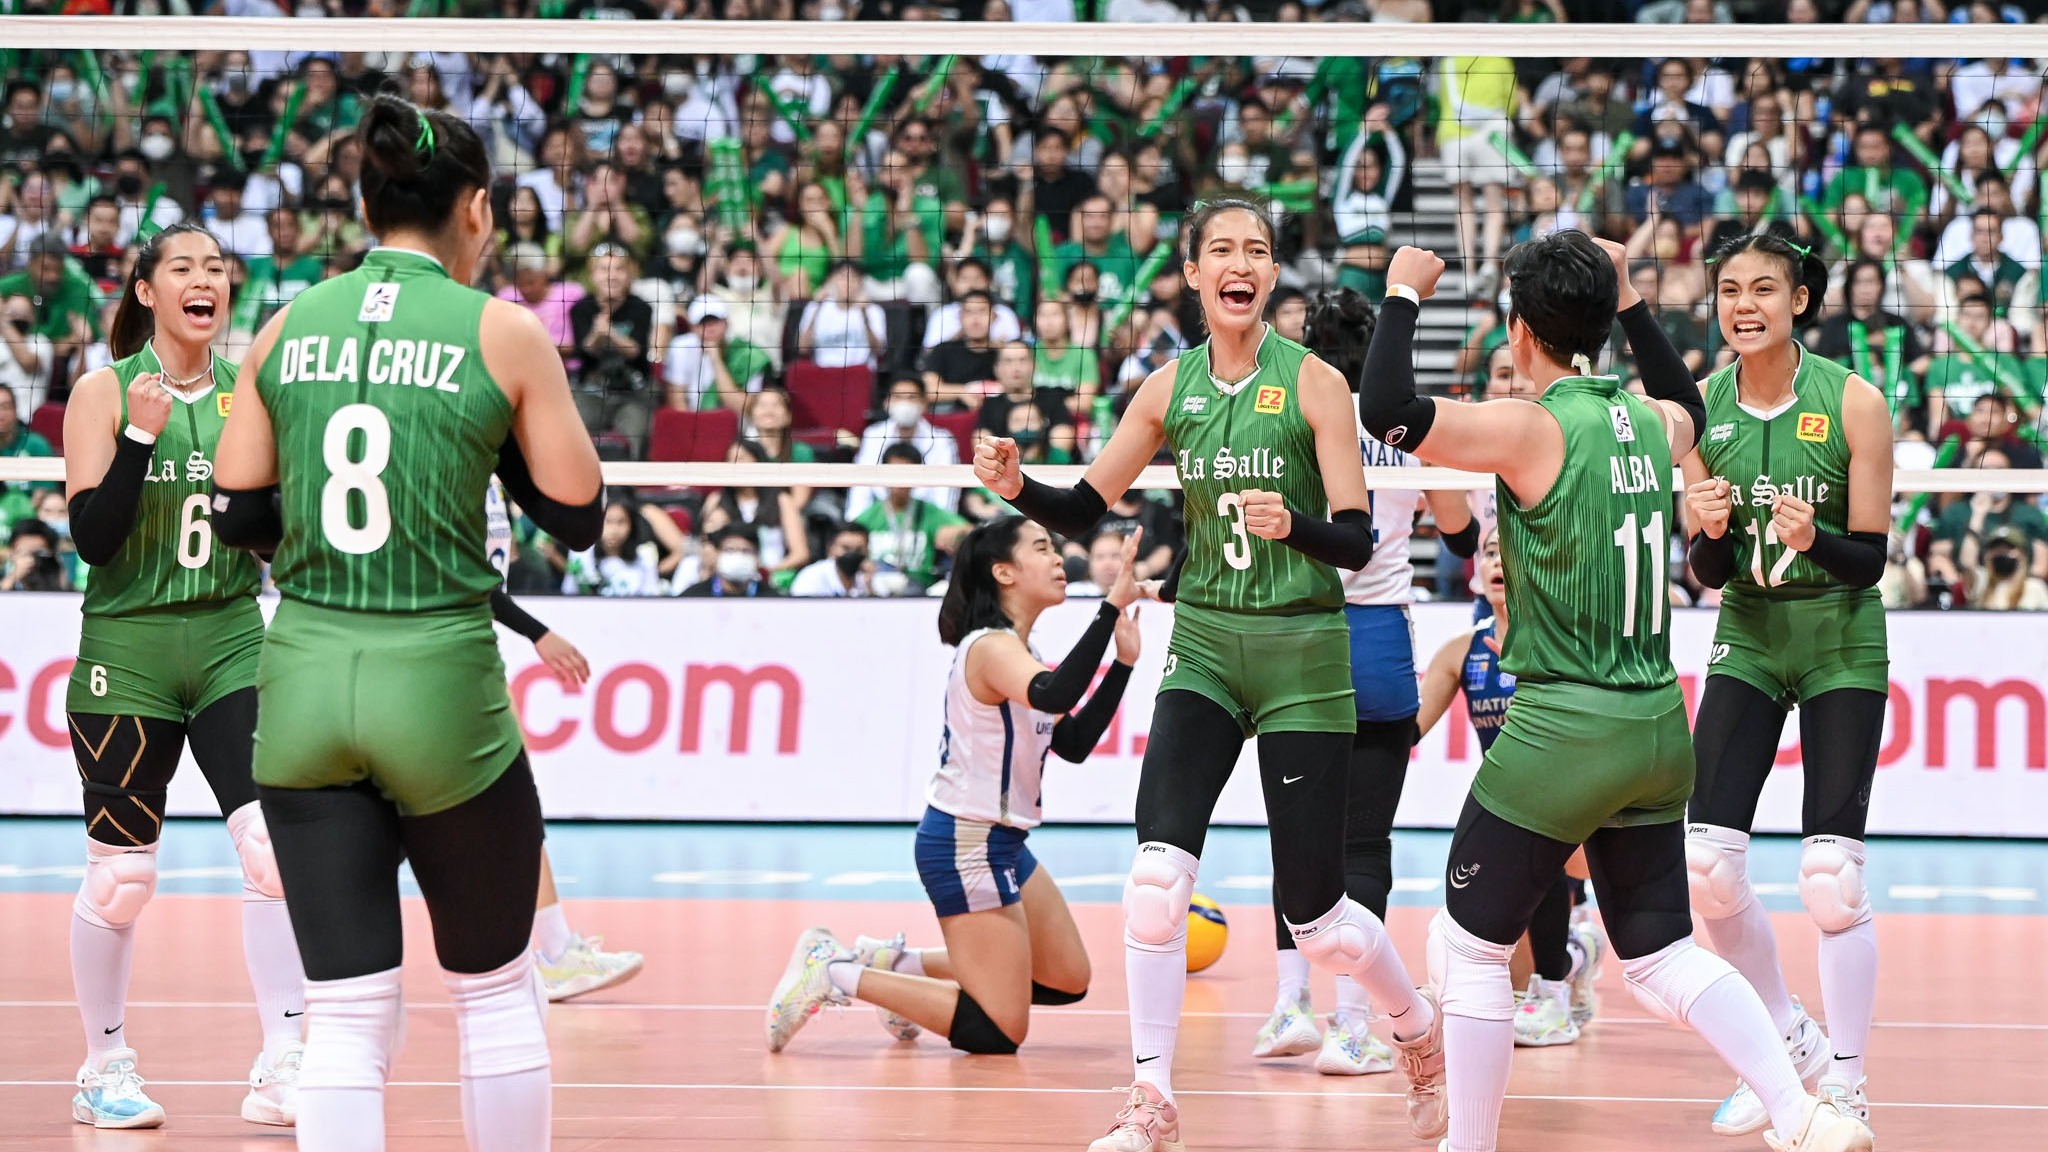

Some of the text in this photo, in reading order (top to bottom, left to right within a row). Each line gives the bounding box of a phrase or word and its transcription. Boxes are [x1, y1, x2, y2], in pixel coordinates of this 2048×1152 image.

[280, 335, 466, 393] DELA CRUZ
[1258, 389, 1282, 406] F2
[1800, 416, 1826, 434] F2
[321, 403, 392, 555] 8
[1178, 446, 1285, 481] La Salle
[1610, 454, 1660, 494] ALBA
[1750, 474, 1830, 508] Salle
[177, 493, 213, 570] 6
[1217, 492, 1252, 571] 3
[1613, 511, 1665, 637] 11
[89, 665, 108, 697] 6
